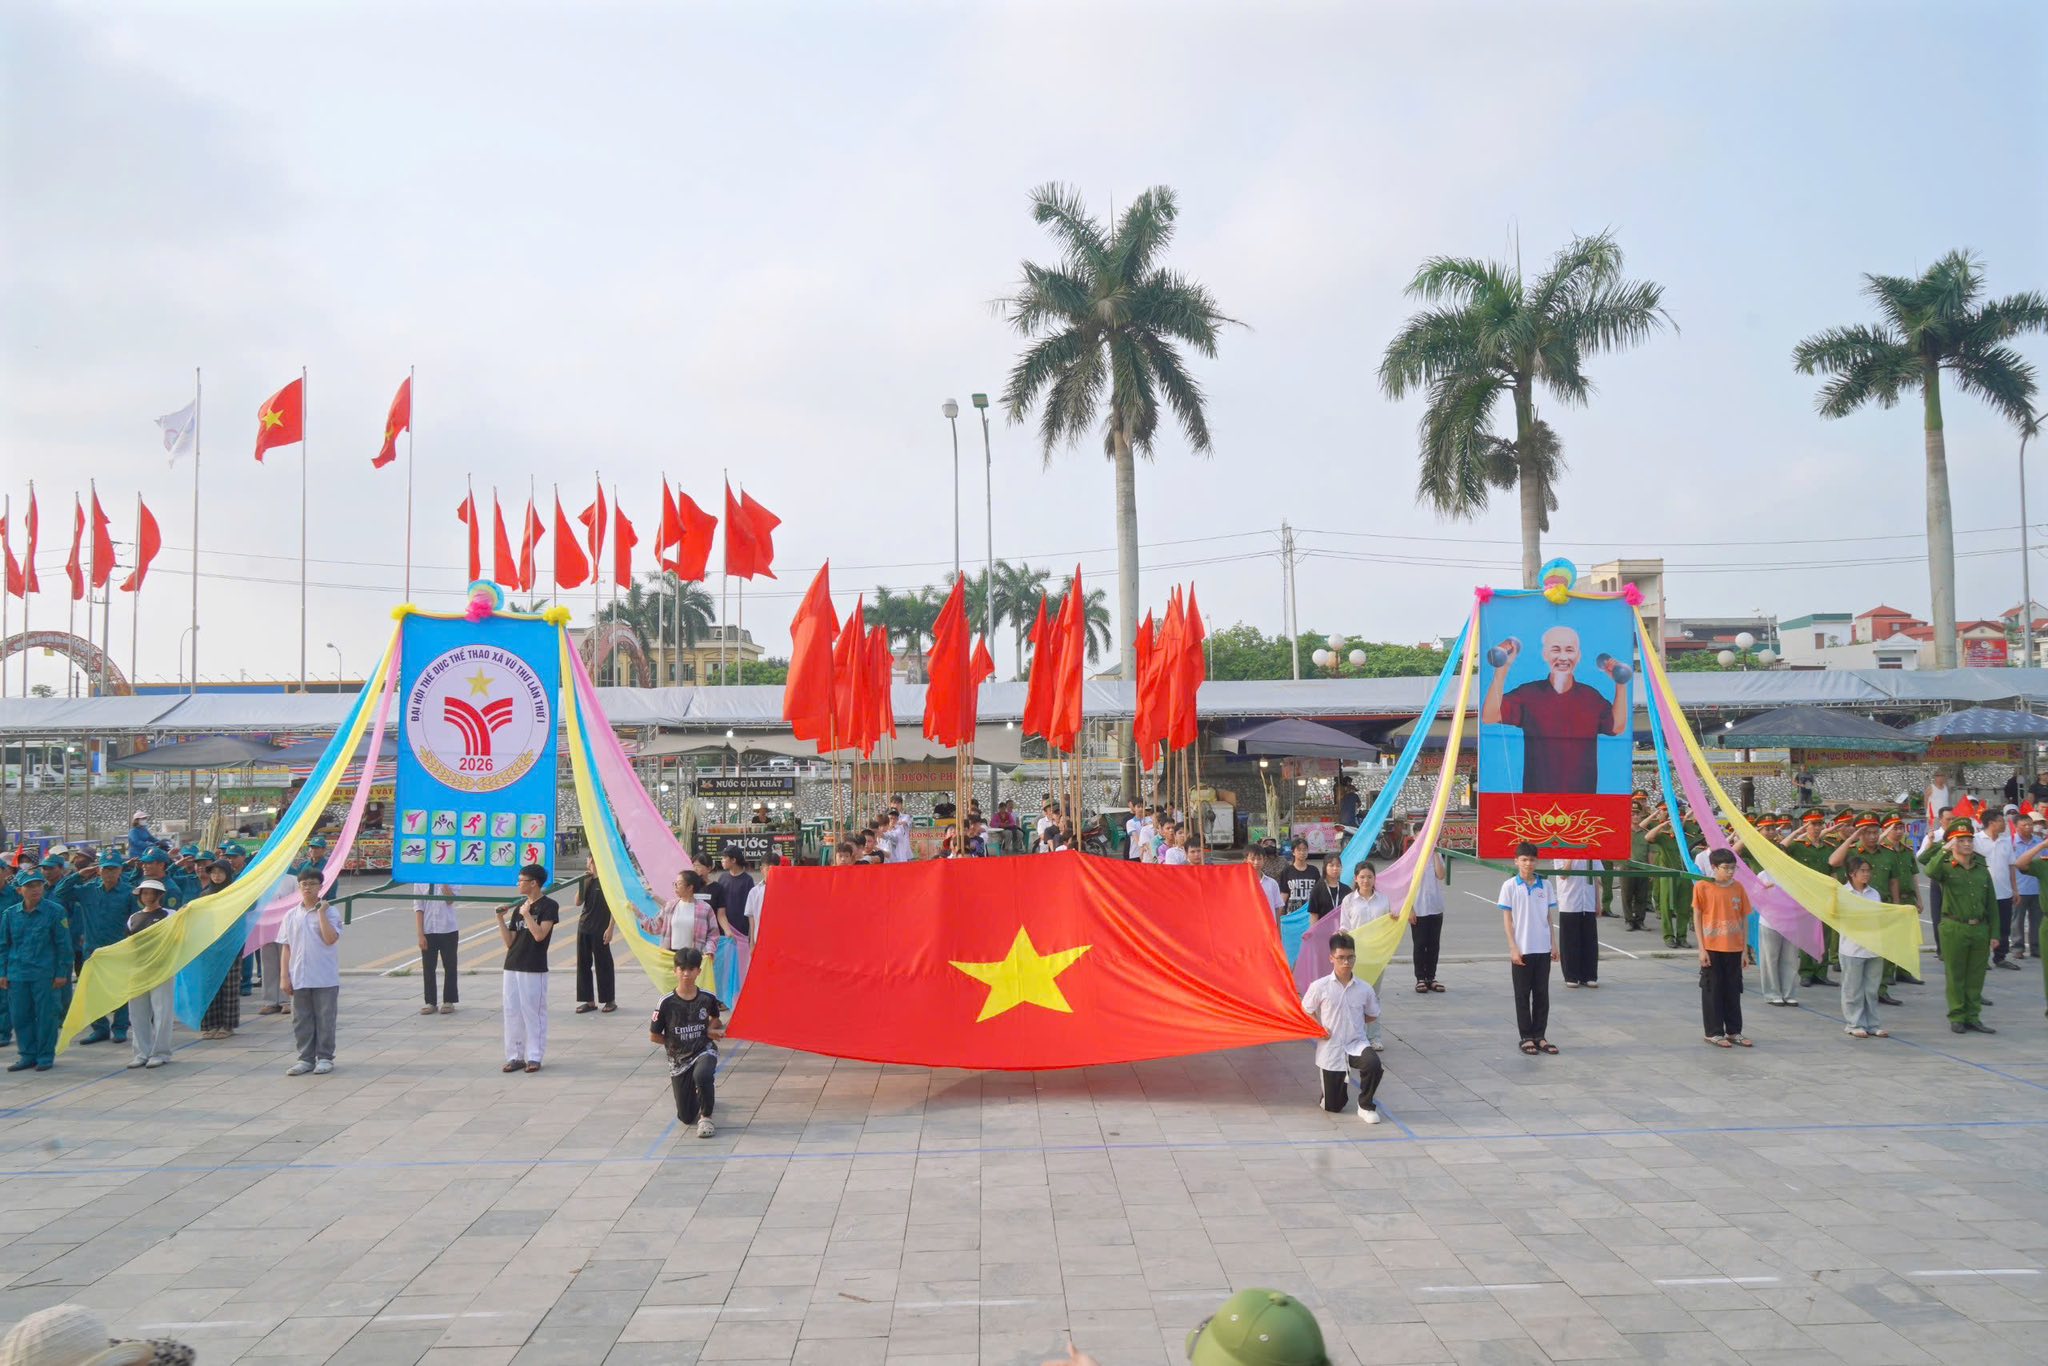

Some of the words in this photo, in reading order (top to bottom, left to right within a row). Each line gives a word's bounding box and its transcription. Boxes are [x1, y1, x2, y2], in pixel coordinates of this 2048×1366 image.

[449, 648, 466, 664] THỂ
[468, 650, 490, 659] THAO
[492, 651, 503, 663] XÃ
[432, 660, 449, 675] DỤC
[505, 657, 518, 669] VŨ
[420, 670, 435, 687] THỂ
[516, 666, 533, 682] THƯ
[413, 689, 425, 705] HỘI
[528, 680, 541, 699] LẦN
[411, 707, 422, 722] ĐẠI
[535, 700, 546, 718] THỨ
[459, 757, 493, 771] 2026
[760, 777, 782, 788] KHÁT
[675, 1023, 705, 1034] Emirates
